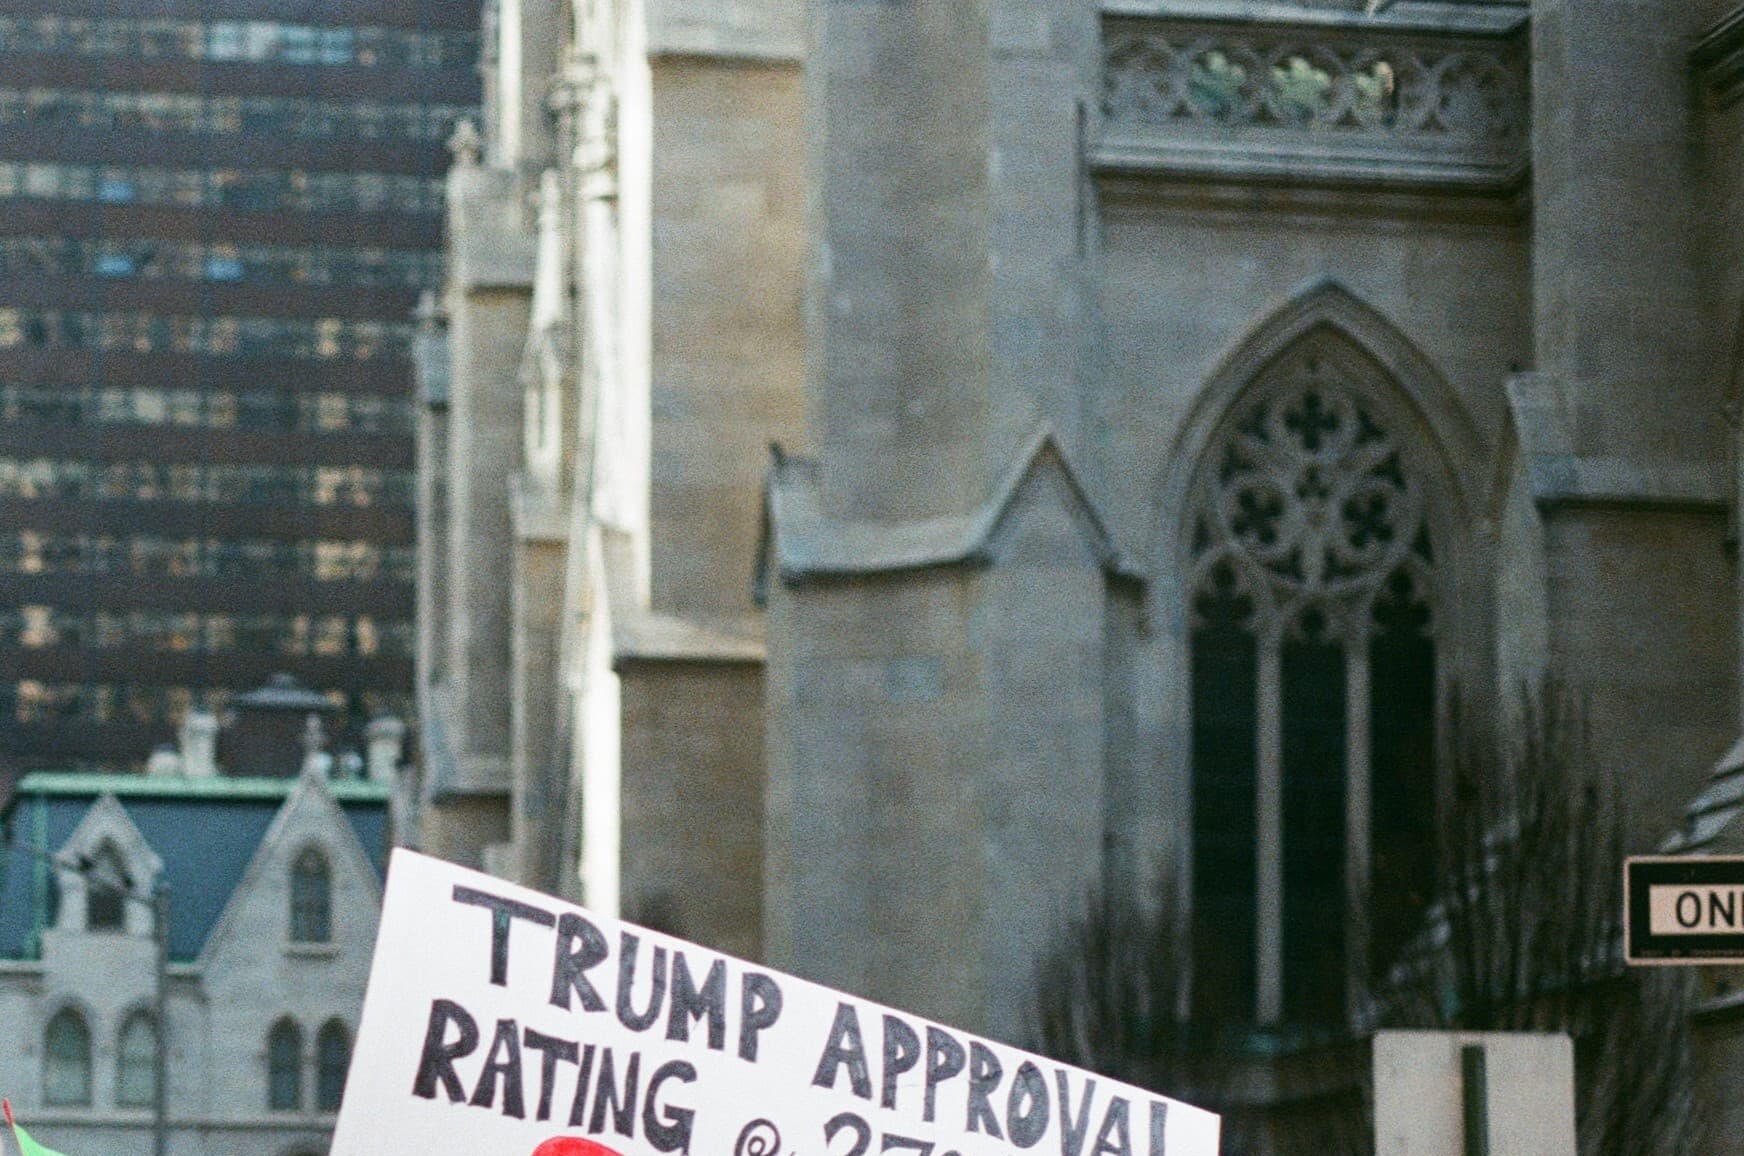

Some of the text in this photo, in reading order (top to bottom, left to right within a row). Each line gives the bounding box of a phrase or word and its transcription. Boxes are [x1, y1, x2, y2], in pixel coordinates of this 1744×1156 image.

[452, 886, 782, 1063] TRUMP
[1675, 890, 1744, 929] ON
[412, 998, 697, 1156] RATING
